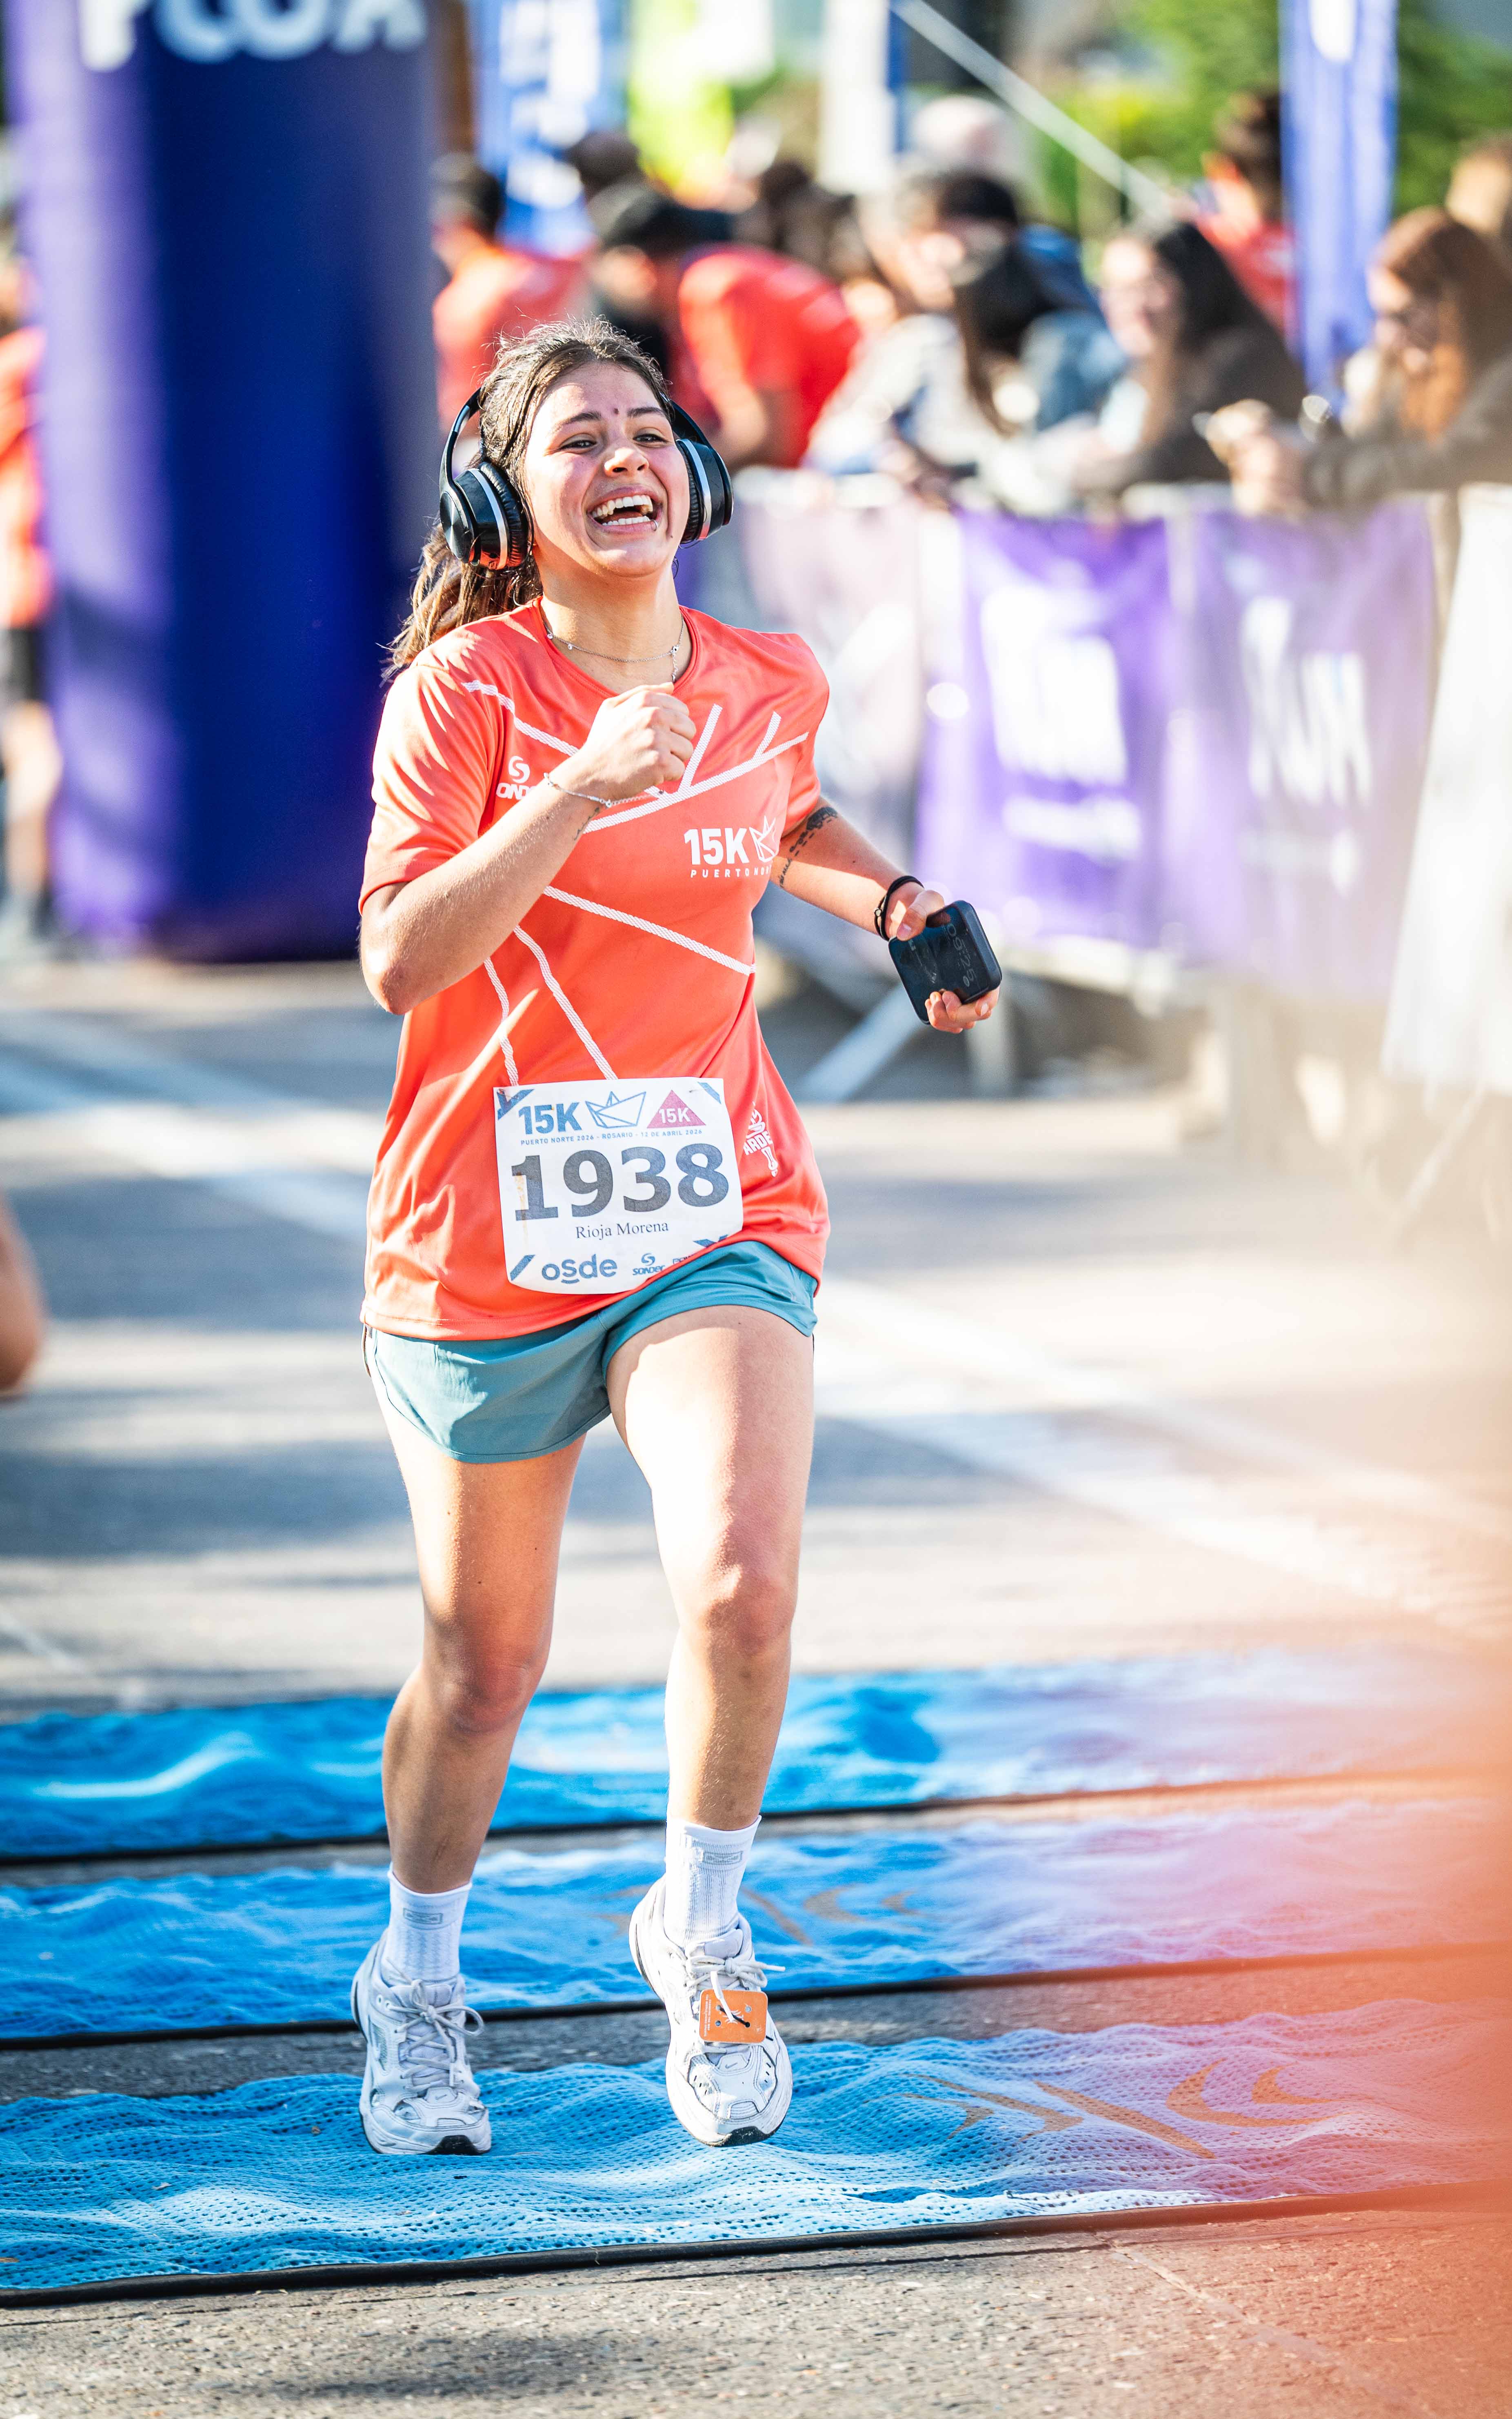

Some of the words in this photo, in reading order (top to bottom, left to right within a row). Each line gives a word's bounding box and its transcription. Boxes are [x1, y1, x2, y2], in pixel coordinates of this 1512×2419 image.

[684, 828, 750, 865] 15K
[691, 868, 750, 878] PUERTO
[754, 865, 772, 876] NOR
[518, 1102, 582, 1135] 15K
[659, 1107, 691, 1124] 15K
[521, 1138, 548, 1146] PUERTO
[743, 1130, 773, 1156] ARDE
[511, 1143, 730, 1222] 1938
[576, 1224, 613, 1241] Rioja
[617, 1220, 669, 1237] Morena
[541, 1253, 618, 1281] osde
